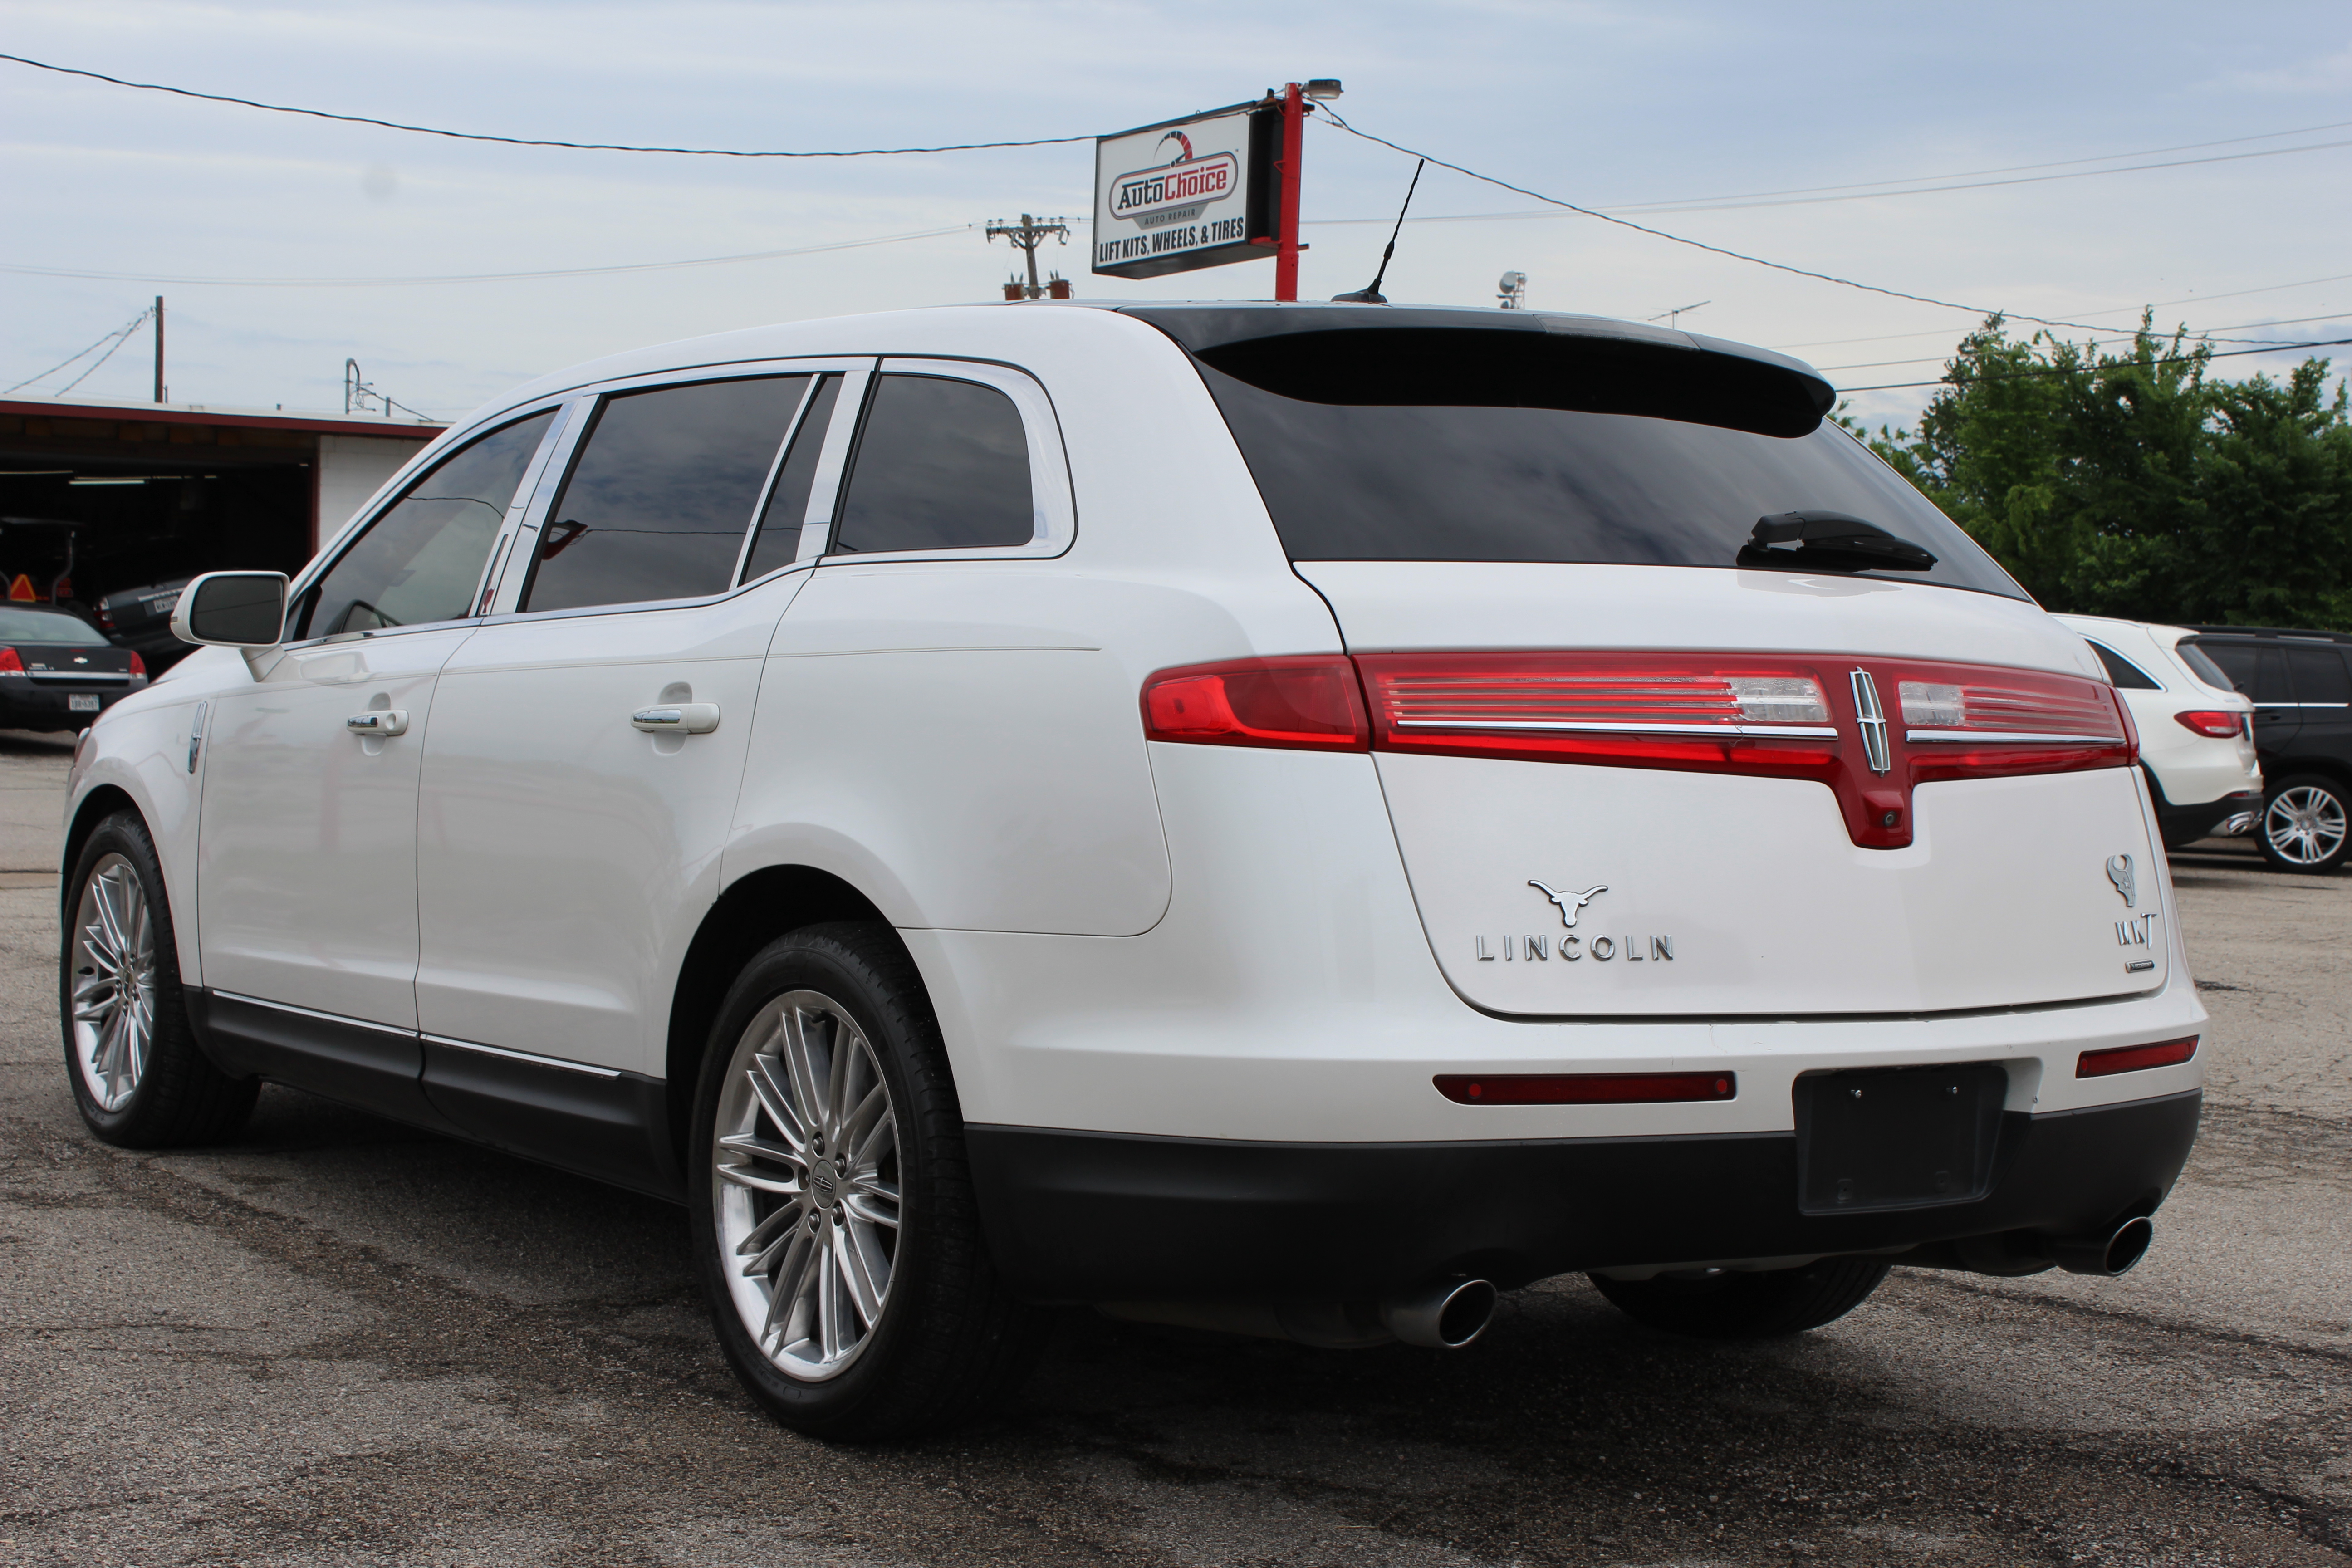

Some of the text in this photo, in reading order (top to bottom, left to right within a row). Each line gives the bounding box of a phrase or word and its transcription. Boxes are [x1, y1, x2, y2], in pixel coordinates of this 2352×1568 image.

[1118, 163, 1228, 210] AutoChoice
[1145, 208, 1196, 225] AUTO REPAIR
[1100, 217, 1244, 262] LIFT KITS, WHEELS, & TIRES
[1476, 934, 1673, 961] LINCOLN
